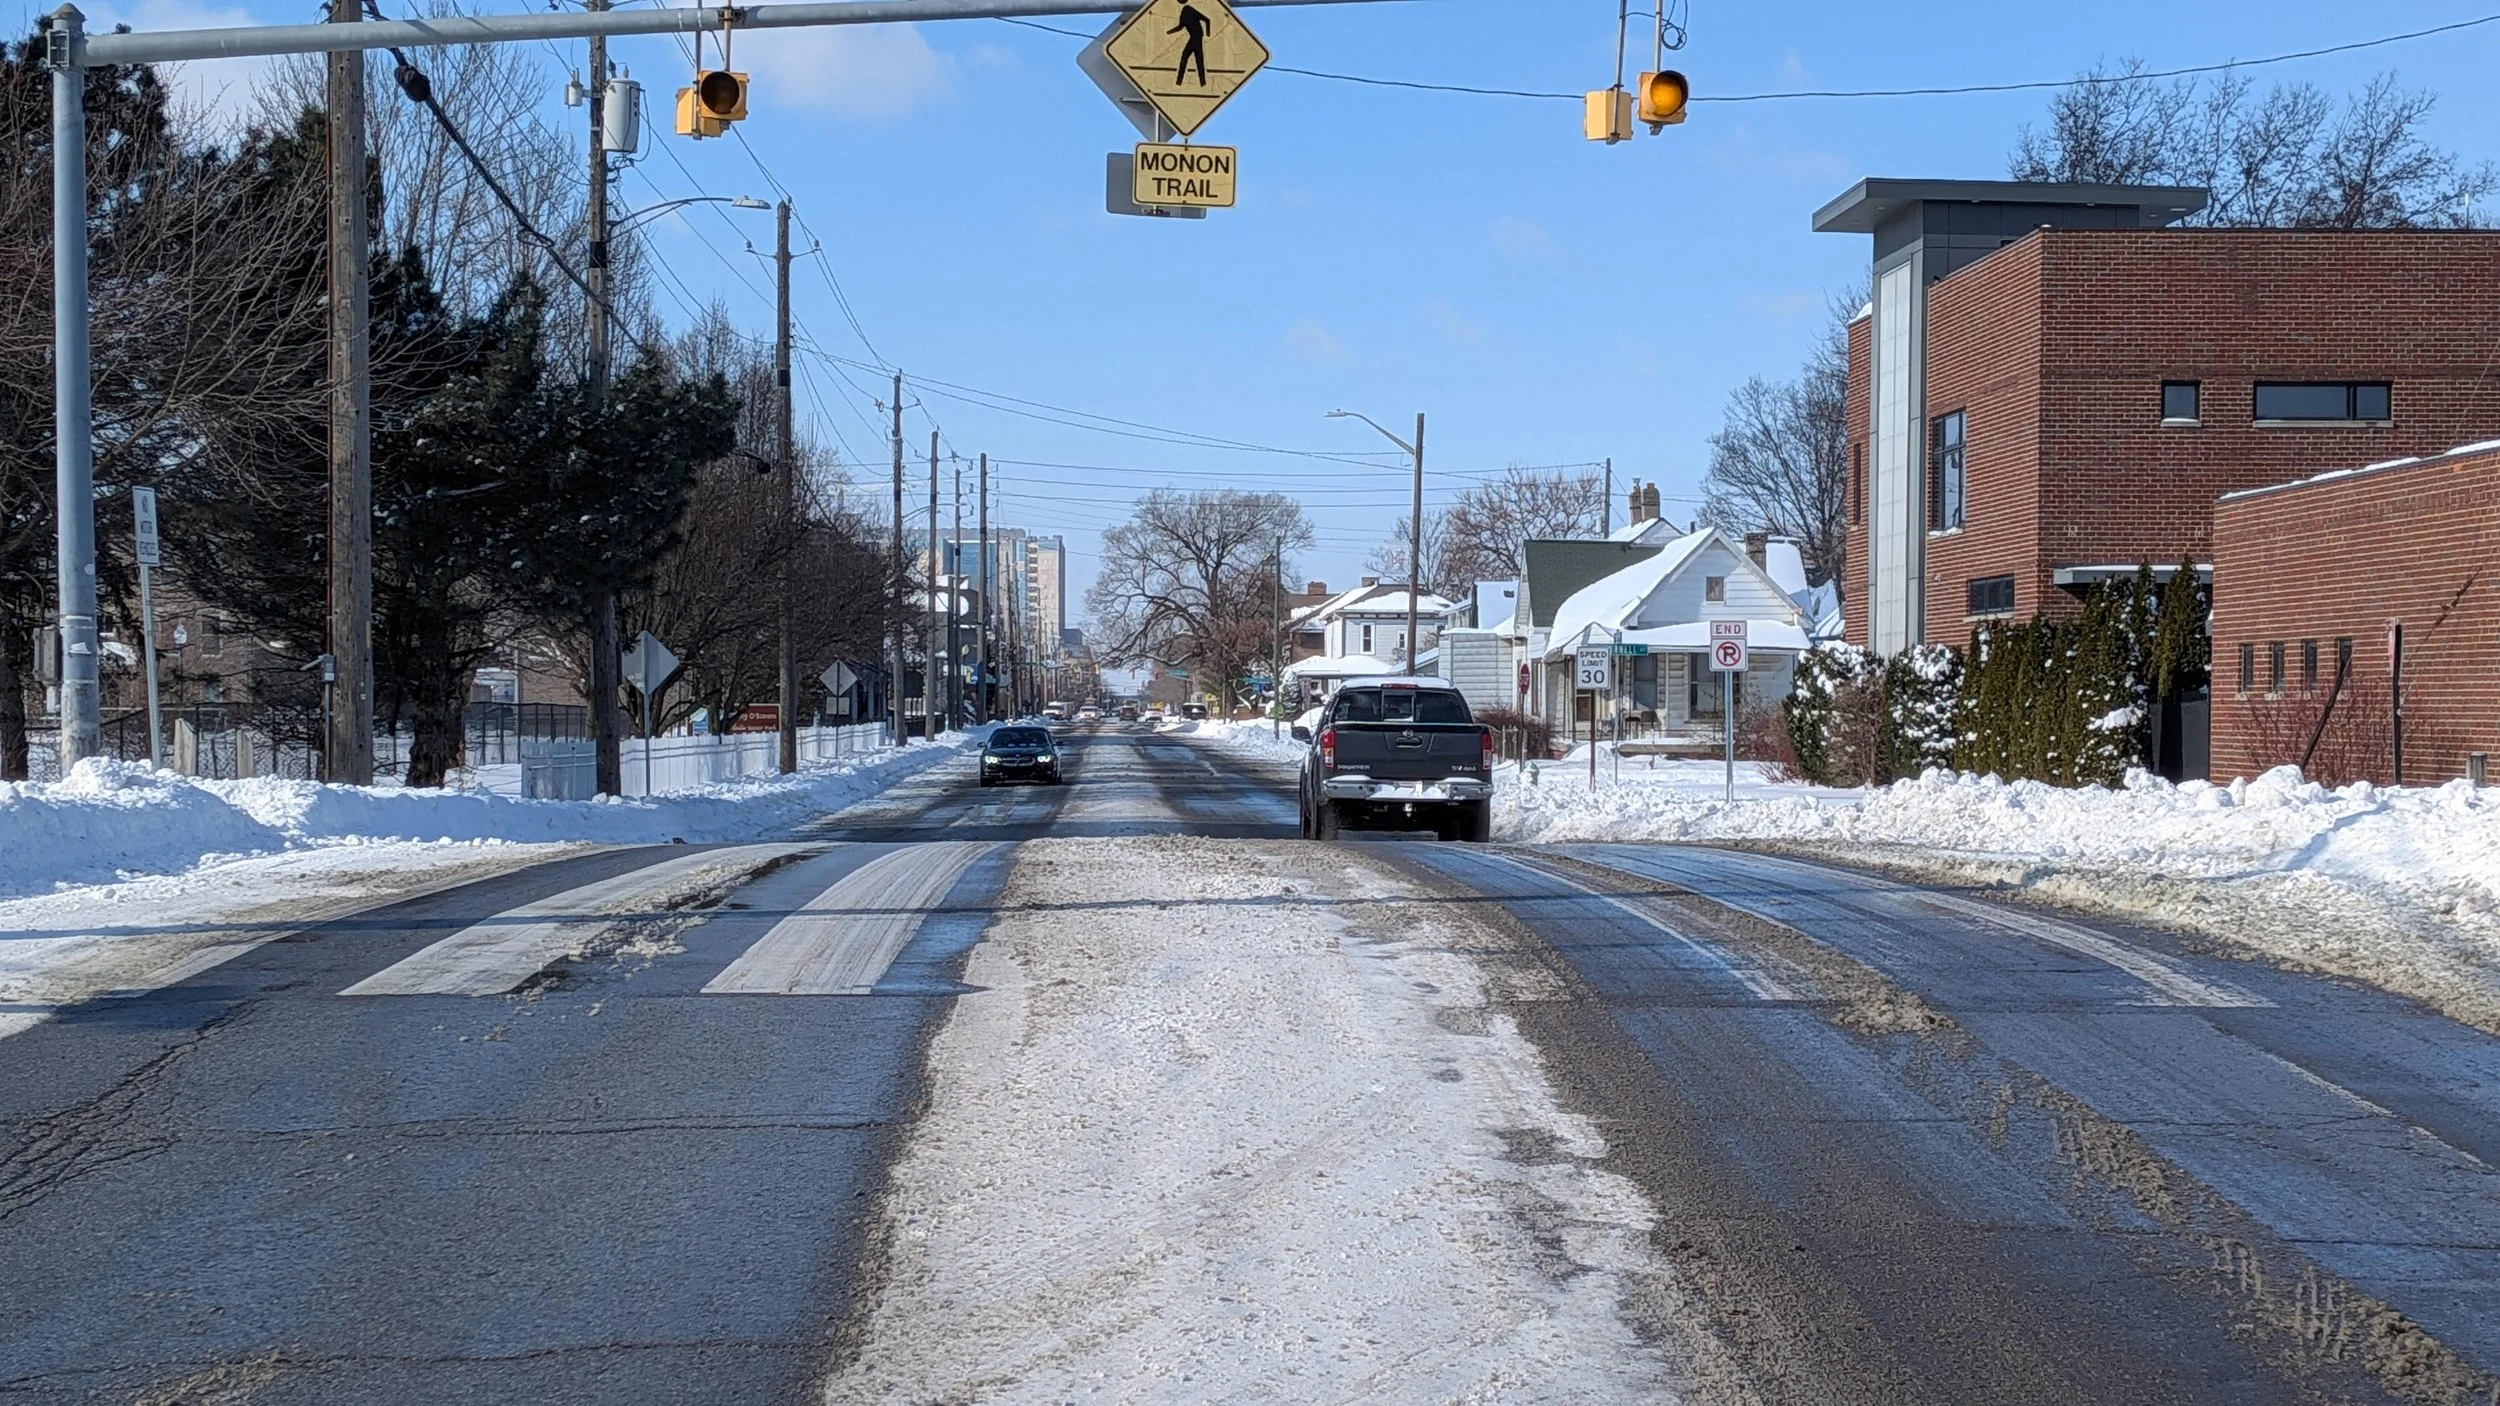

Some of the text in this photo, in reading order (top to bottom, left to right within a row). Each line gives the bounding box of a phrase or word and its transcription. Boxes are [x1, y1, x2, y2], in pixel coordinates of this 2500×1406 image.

[1140, 152, 1230, 174] MONON
[1151, 177, 1219, 198] TRAIL
[1715, 624, 1742, 635] END
[1580, 651, 1607, 659] SPEED
[1581, 669, 1605, 684] 30
